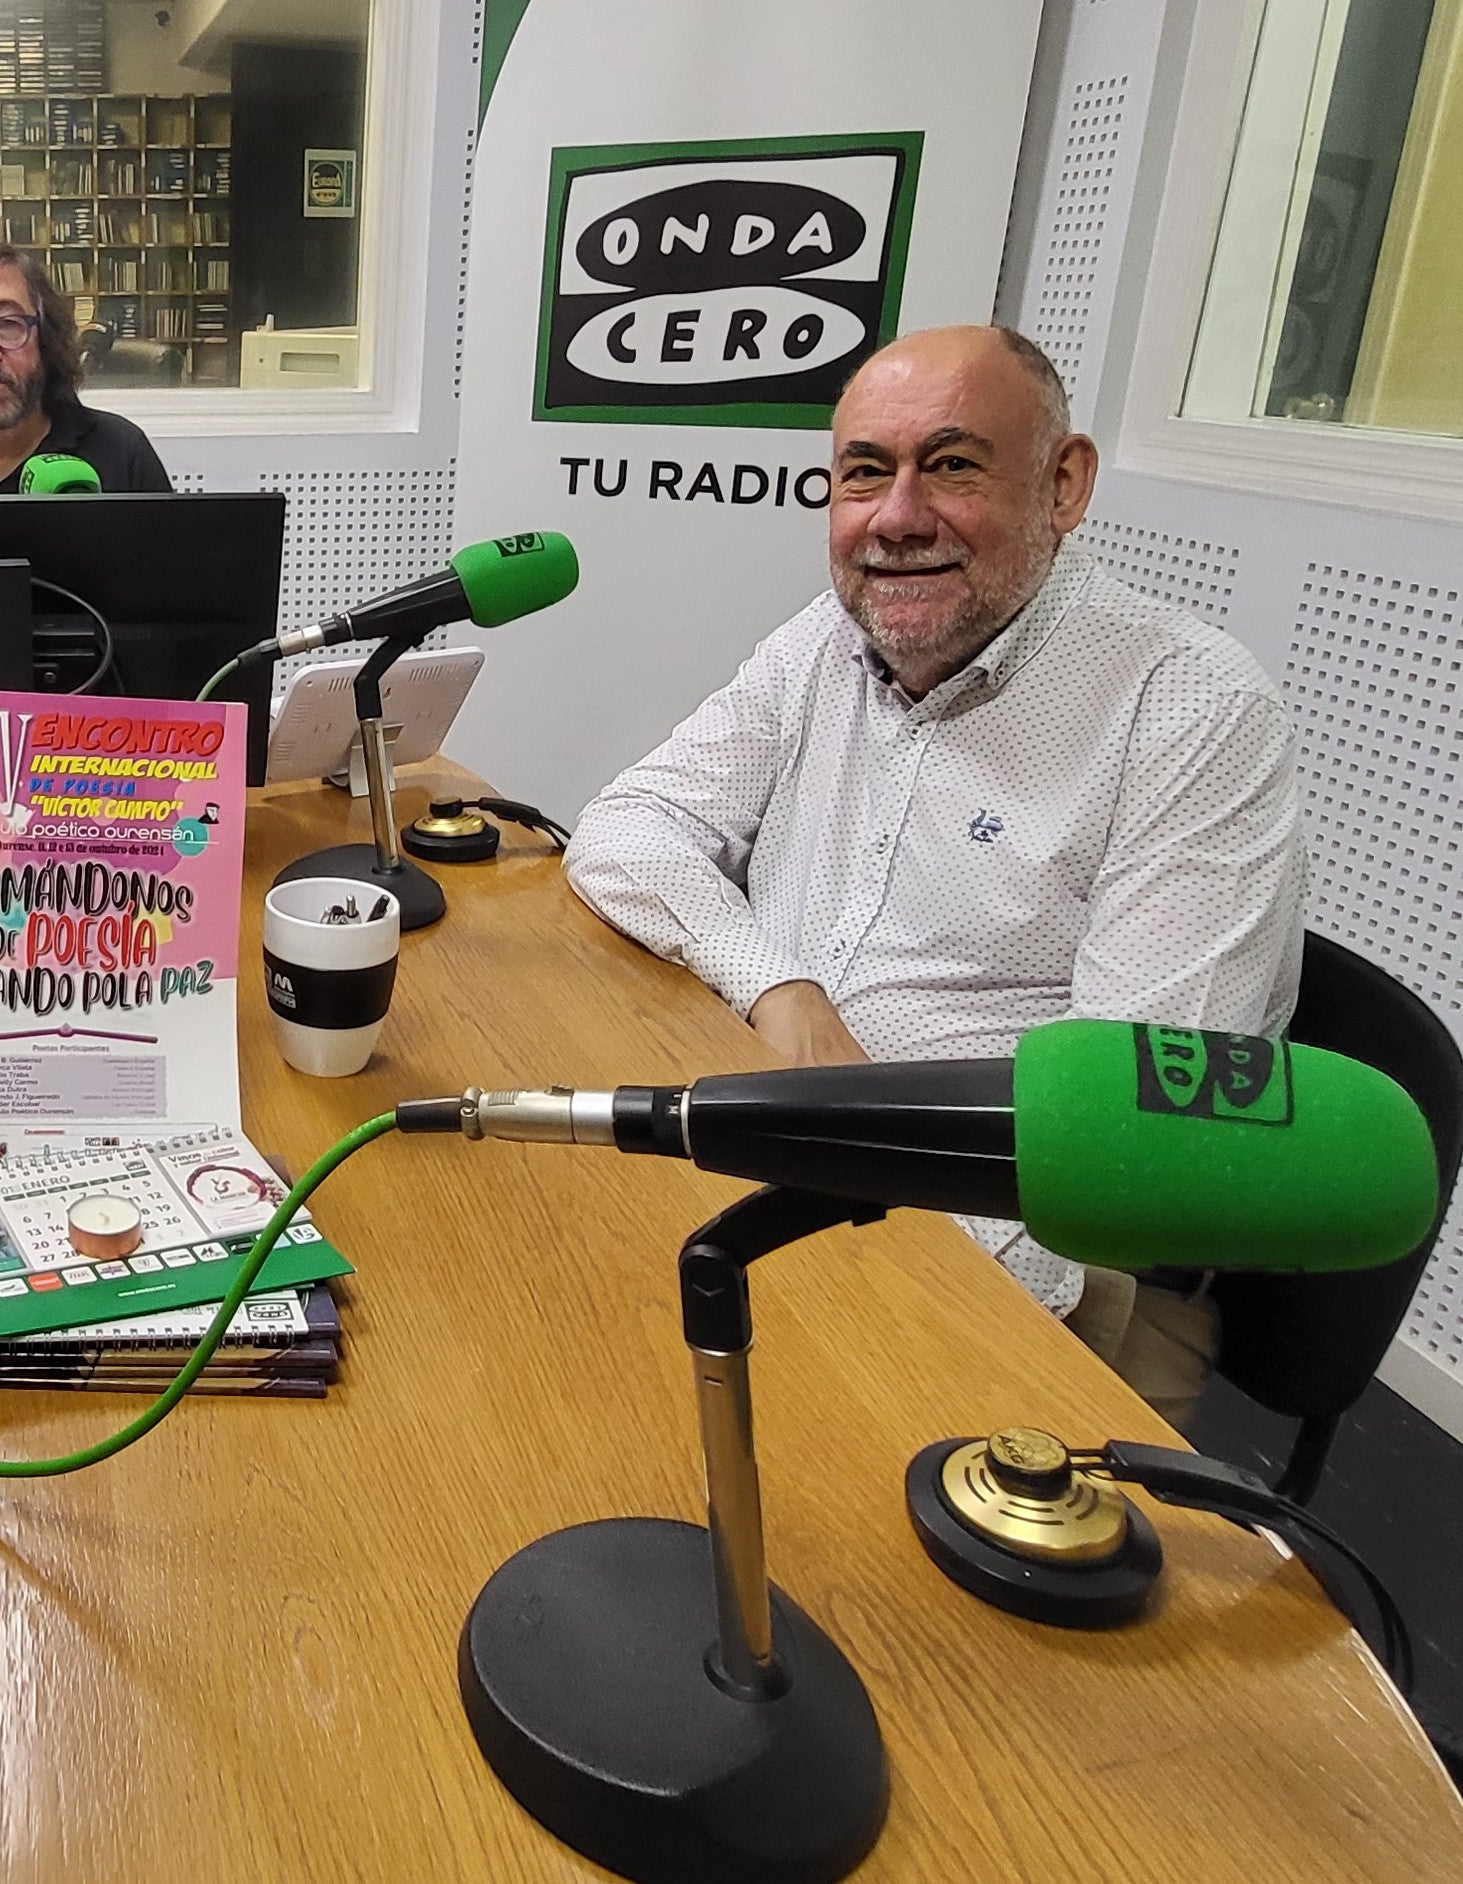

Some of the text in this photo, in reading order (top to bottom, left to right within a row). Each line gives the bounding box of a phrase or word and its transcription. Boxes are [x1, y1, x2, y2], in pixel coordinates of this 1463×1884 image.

[602, 212, 833, 265] ONDA
[606, 309, 825, 363] CERO
[560, 457, 831, 509] TU RADIO
[30, 713, 224, 757] ENCONTRO
[30, 755, 218, 780] INTERNACIONAL
[28, 778, 52, 793] DE
[32, 822, 100, 841] poético
[105, 825, 194, 841] ourensán
[26, 900, 157, 972] POESÍA
[83, 970, 154, 1010] POLA
[160, 960, 215, 1001] PAZ
[32, 1044, 110, 1053] Poetas Participantes
[22, 1175, 71, 1192] ENERO
[122, 1184, 131, 1192] 4
[142, 1180, 151, 1188] 5
[23, 1216, 32, 1224] 6
[44, 1212, 52, 1220] 7
[147, 1192, 164, 1200] 12
[26, 1228, 42, 1237] 13
[48, 1224, 65, 1233] 14
[156, 1204, 171, 1213] 19
[32, 1241, 50, 1250] 20
[142, 1221, 159, 1230] 25
[164, 1216, 182, 1225] 26
[40, 1254, 56, 1263] 27
